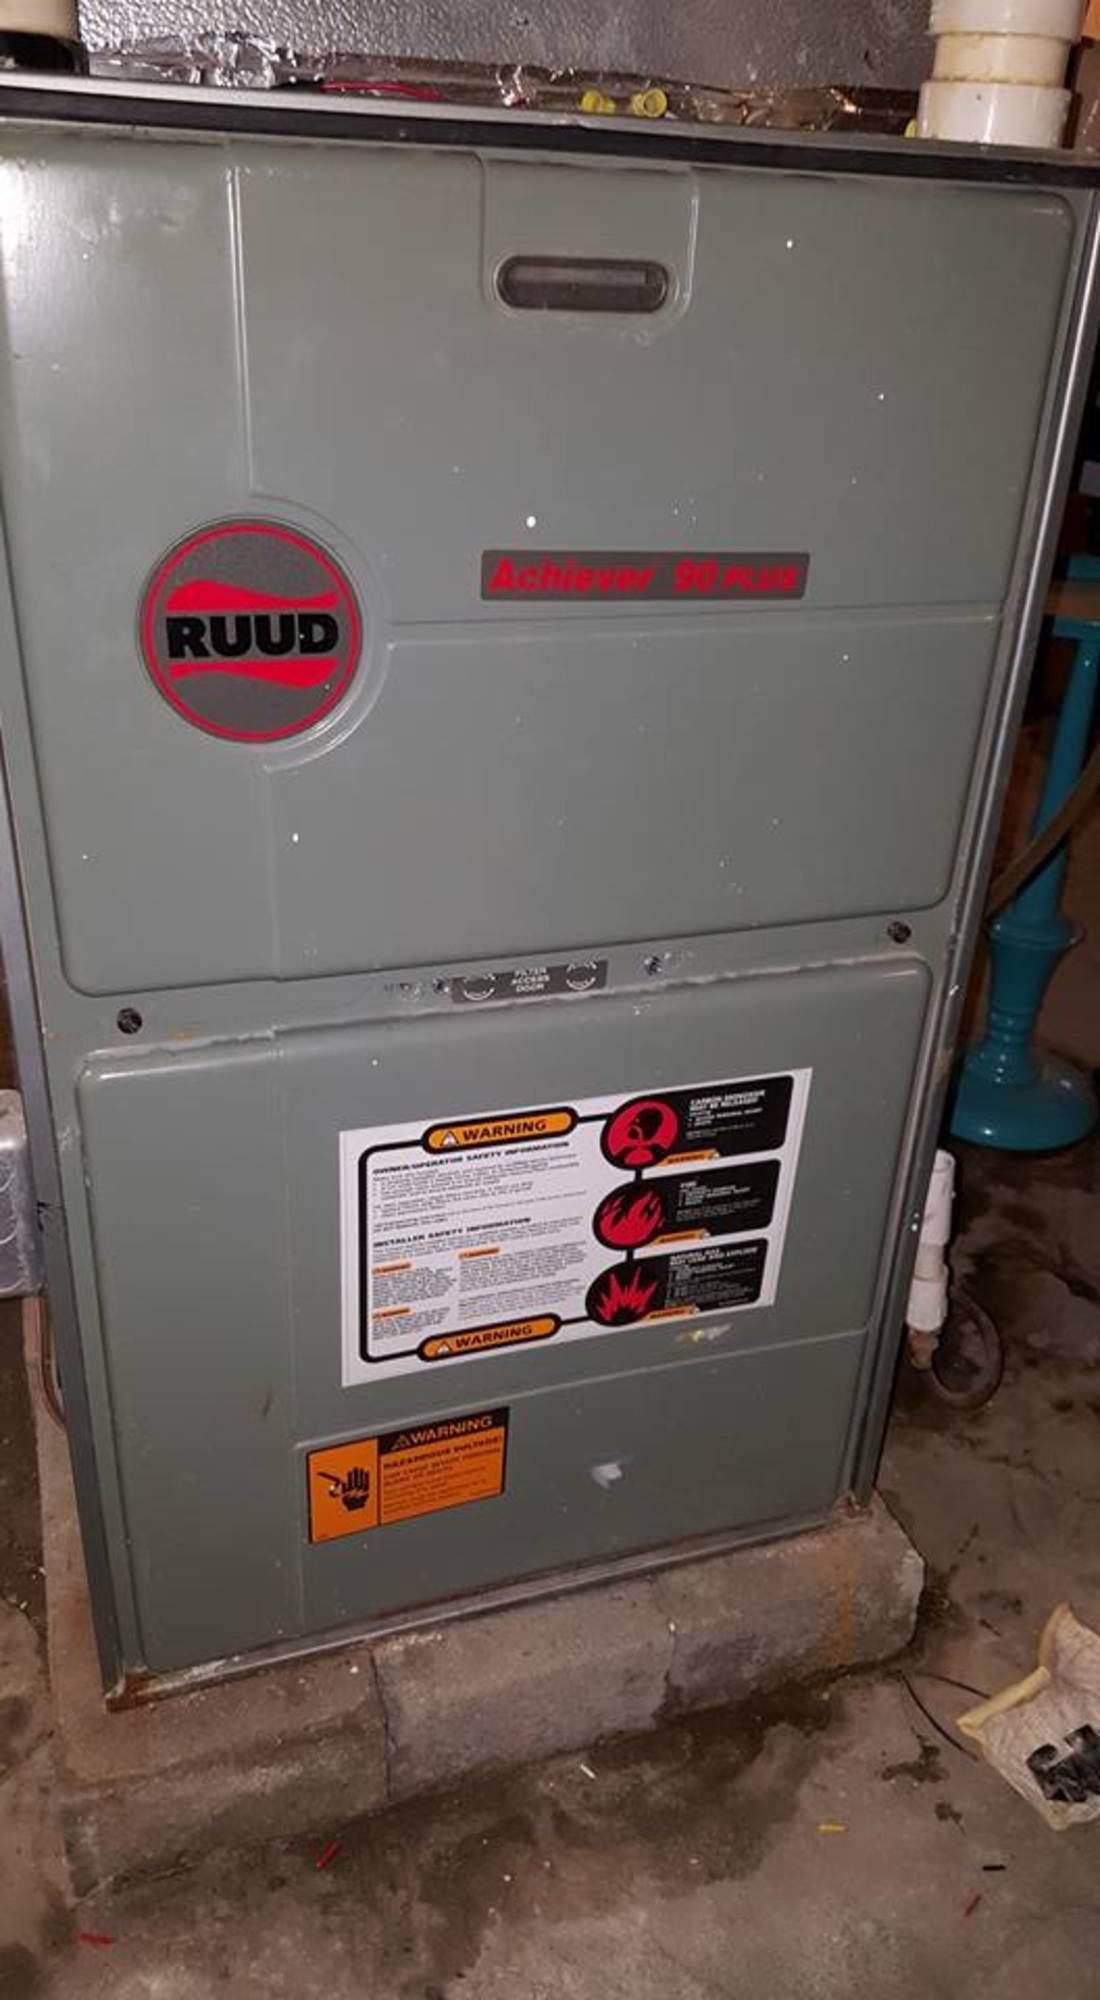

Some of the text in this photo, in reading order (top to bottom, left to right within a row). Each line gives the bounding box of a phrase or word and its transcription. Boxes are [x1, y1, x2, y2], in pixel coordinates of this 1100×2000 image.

[487, 556, 800, 595] Achiever 90 PLUS
[165, 612, 339, 659] RUUD
[511, 974, 550, 985] ACCESS
[514, 966, 547, 977] FILTER
[515, 982, 545, 993] DOOR
[462, 1118, 547, 1141] WARNING
[466, 1151, 501, 1161] SAFETY
[372, 1233, 426, 1248] INSTALLER
[428, 1227, 463, 1238] SAFETY
[455, 1324, 533, 1348] WARNING
[409, 1415, 493, 1444] WARNING
